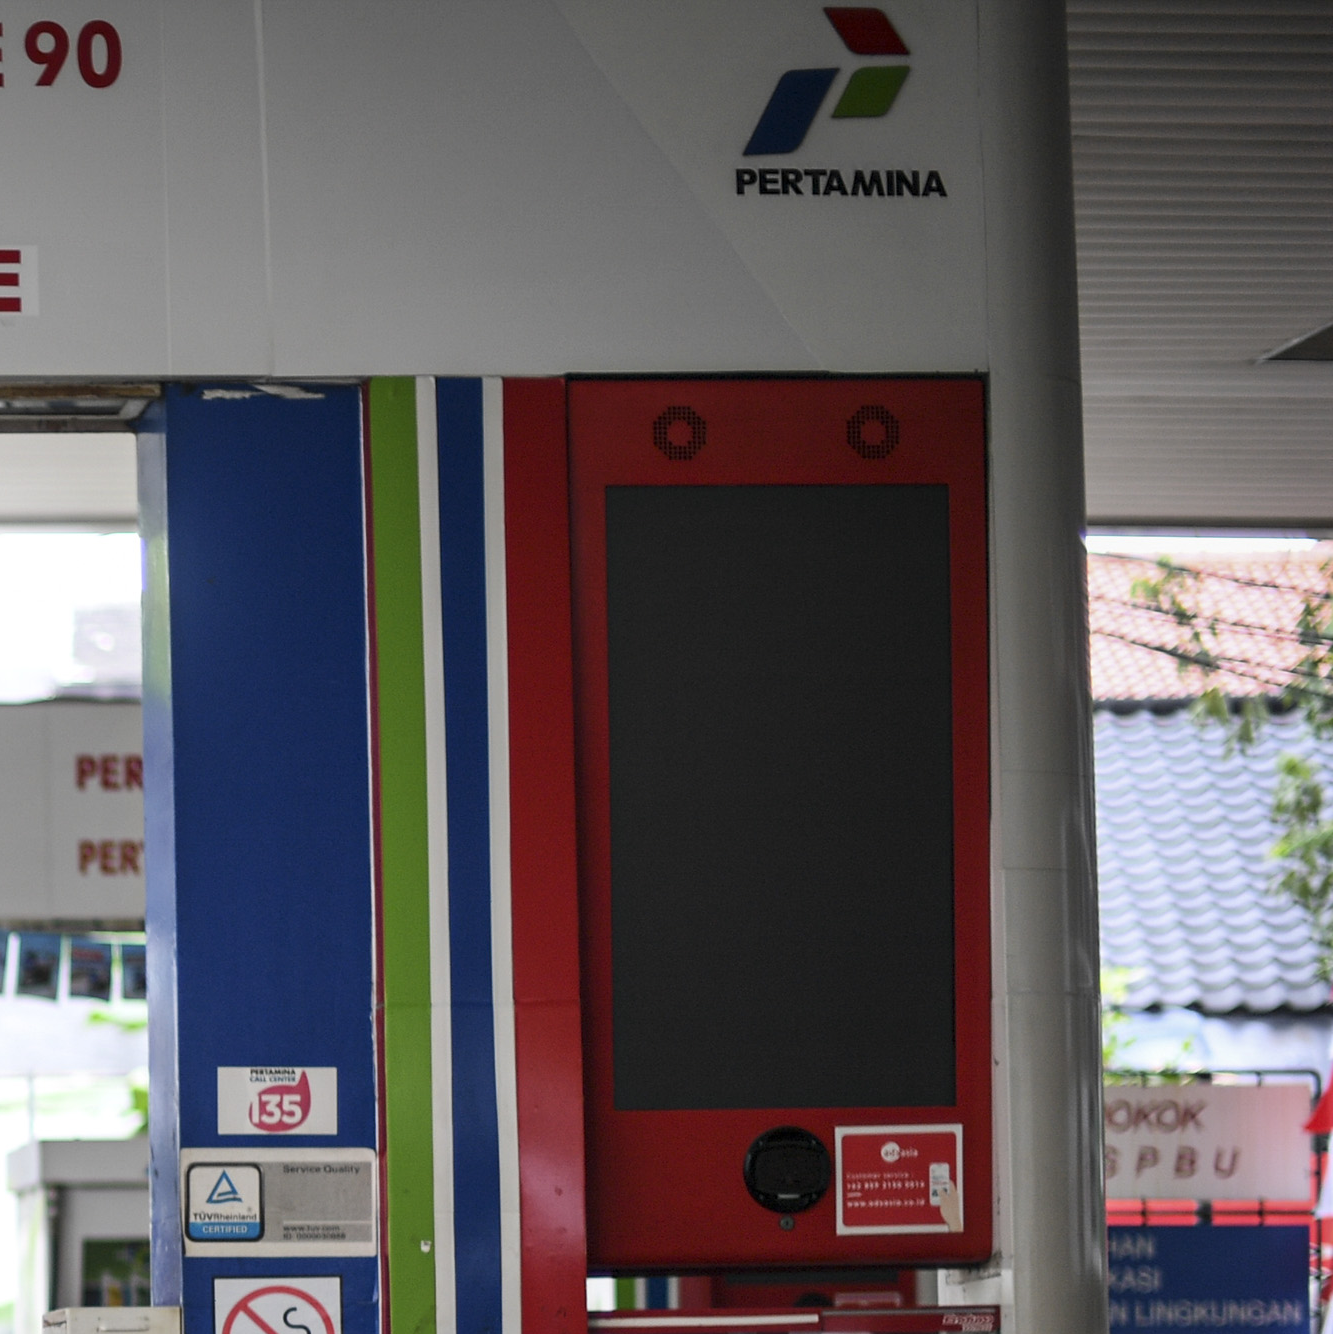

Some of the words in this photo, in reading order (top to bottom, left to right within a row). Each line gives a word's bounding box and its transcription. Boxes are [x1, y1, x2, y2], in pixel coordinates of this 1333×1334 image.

[23, 20, 121, 89] 90
[735, 168, 947, 197] PERTAMINA
[251, 1094, 303, 1124] 135
[1105, 1099, 1206, 1133] OKOK
[283, 1165, 321, 1174] Service
[323, 1165, 360, 1175] Quality
[203, 1225, 248, 1233] CERTIFIED
[1135, 1299, 1302, 1327] LINGKUNGAN
